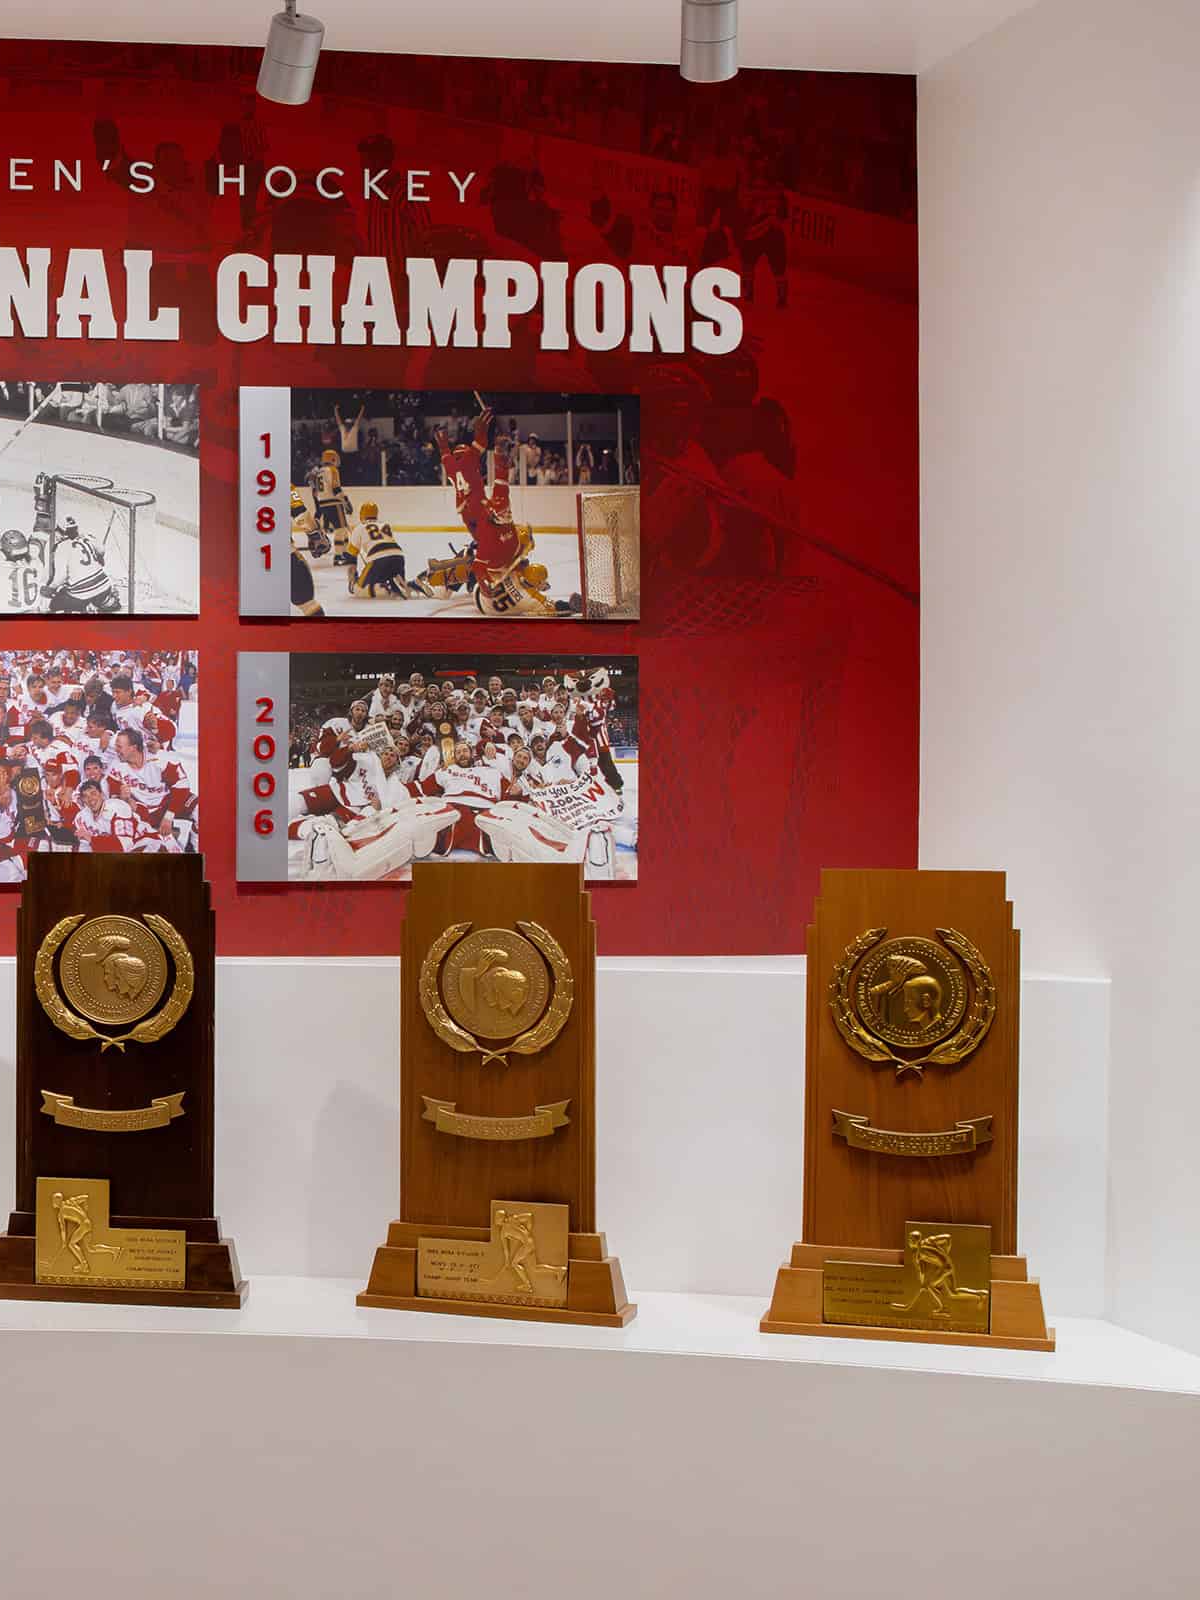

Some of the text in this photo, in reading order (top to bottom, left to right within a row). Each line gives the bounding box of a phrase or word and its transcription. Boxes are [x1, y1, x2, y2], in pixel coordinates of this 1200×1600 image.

[217, 164, 477, 203] HOCKEY
[216, 252, 743, 356] CHAMPIONS
[256, 432, 276, 570] 1981
[7, 567, 39, 608] 16
[253, 697, 276, 836] 2006
